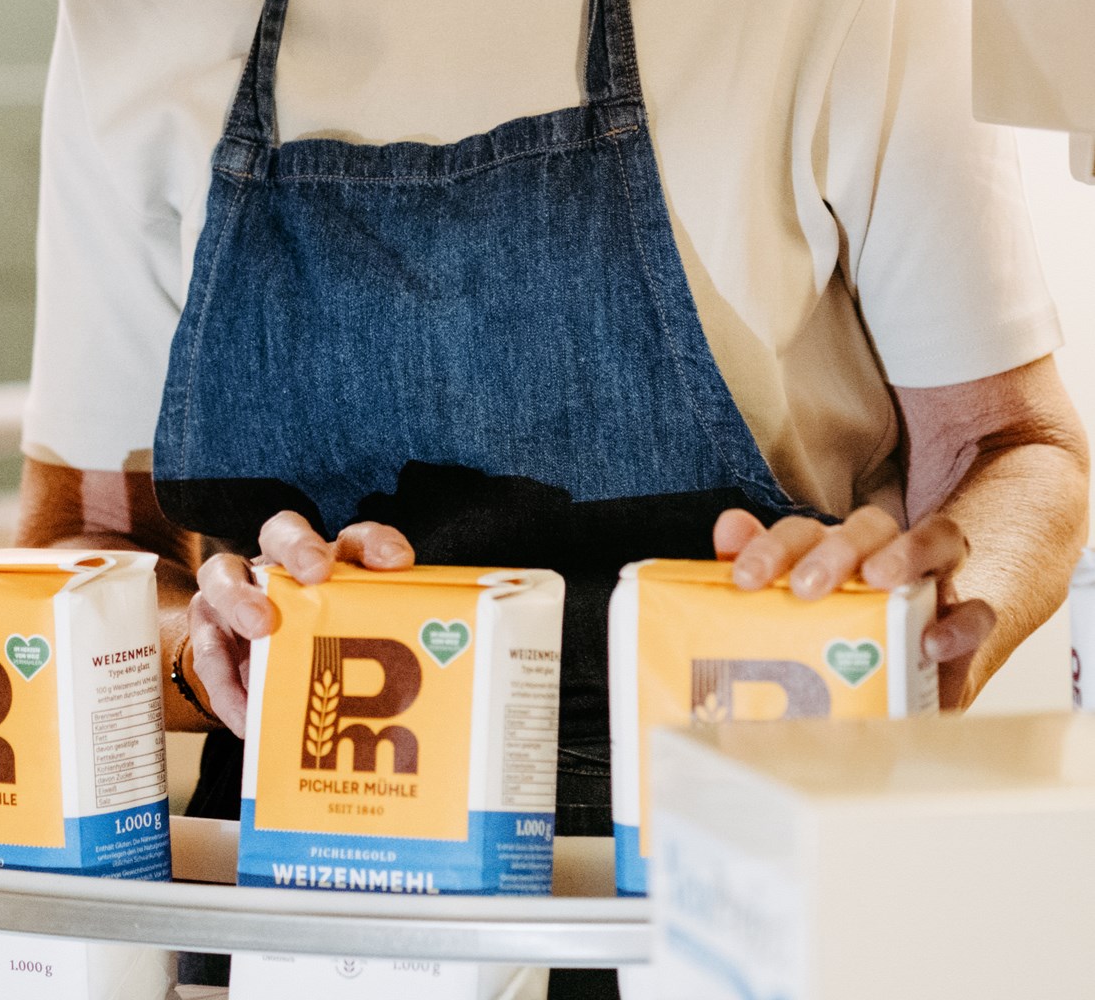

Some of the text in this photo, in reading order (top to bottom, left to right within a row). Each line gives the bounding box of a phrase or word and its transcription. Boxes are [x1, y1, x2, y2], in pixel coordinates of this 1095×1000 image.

[108, 669, 124, 679] Type
[299, 779, 418, 798] PICHLER MÜHLE
[328, 803, 385, 816] SEIT 1840
[115, 812, 162, 834] 1.000 g
[515, 819, 551, 841] 1.000 g
[310, 847, 397, 862] PICHLERGOLD
[272, 863, 440, 895] WEIZENMEHL
[9, 959, 53, 977] 1.000 g
